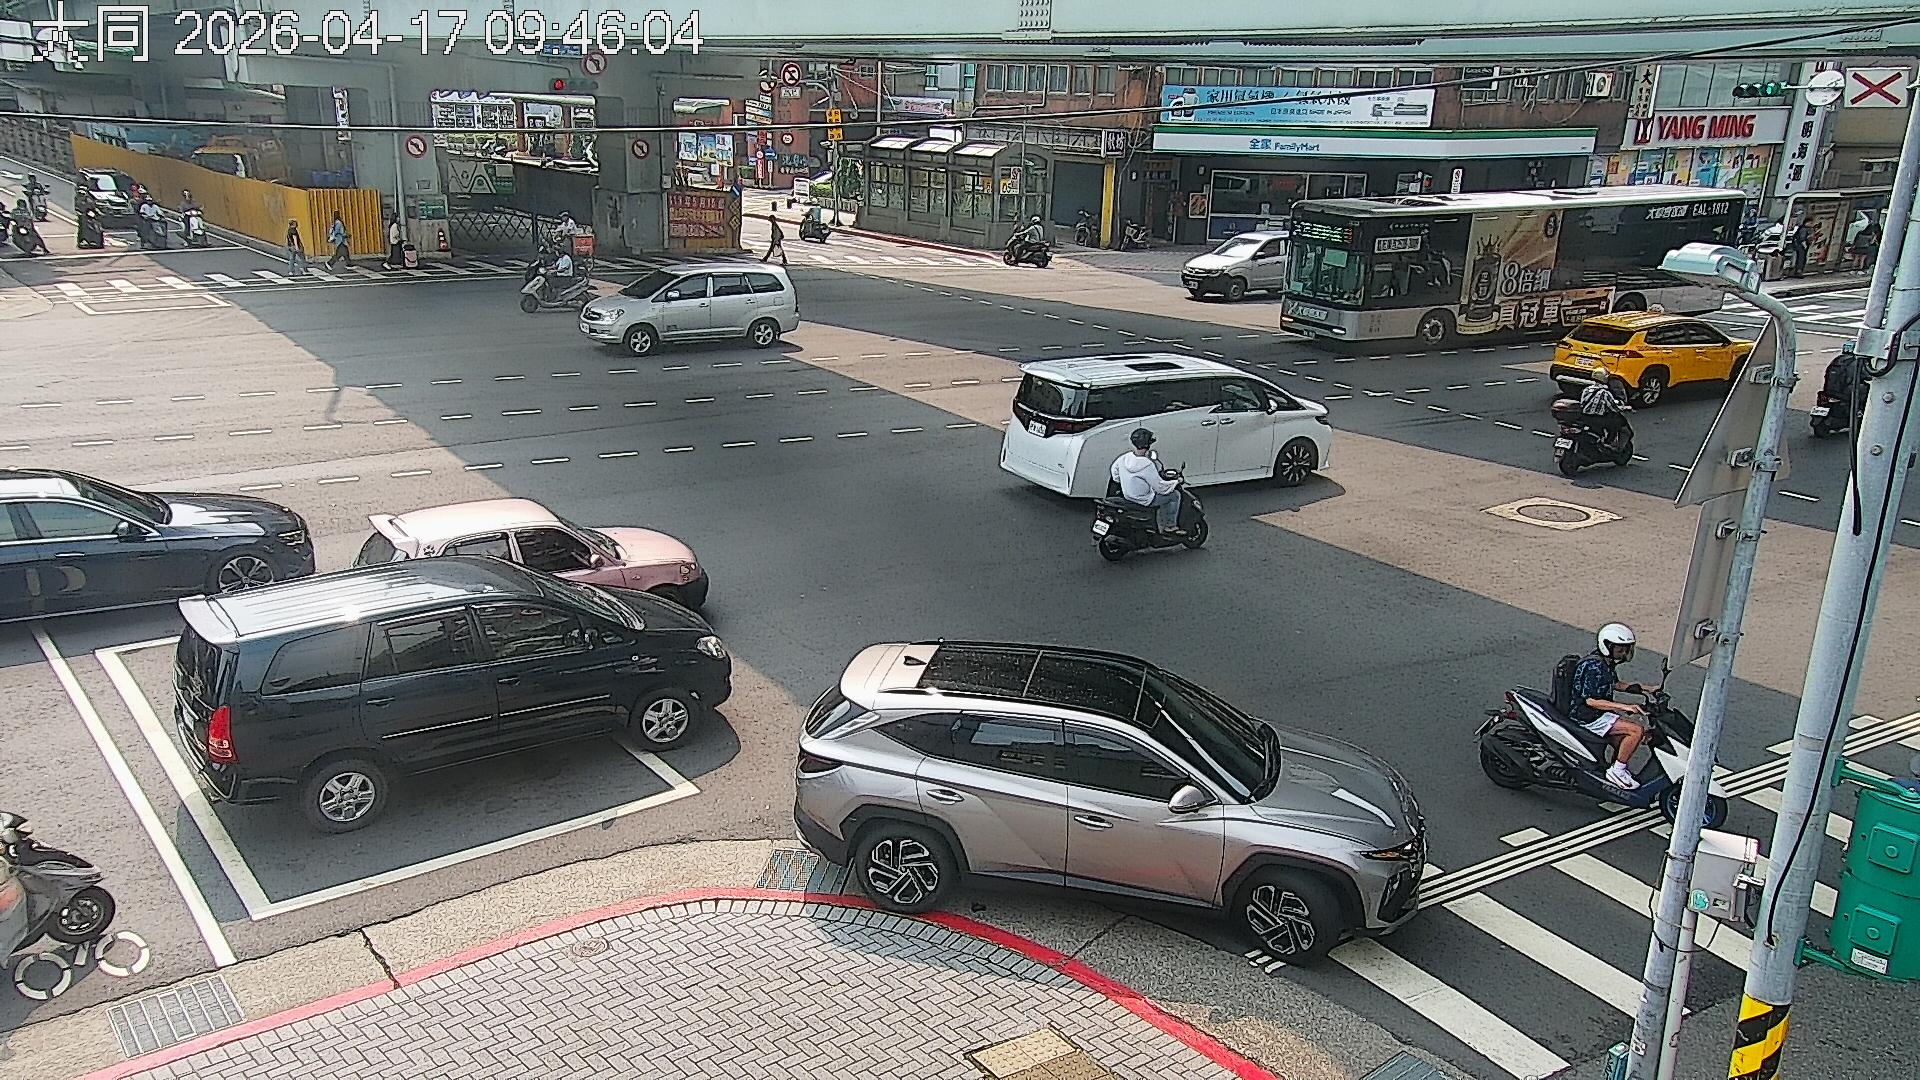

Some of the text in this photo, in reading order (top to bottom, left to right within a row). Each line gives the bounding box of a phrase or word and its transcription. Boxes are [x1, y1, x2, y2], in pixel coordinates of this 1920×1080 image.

[1658, 114, 1757, 140] YANG MING
[1249, 138, 1320, 153] 全家 FamilyMart
